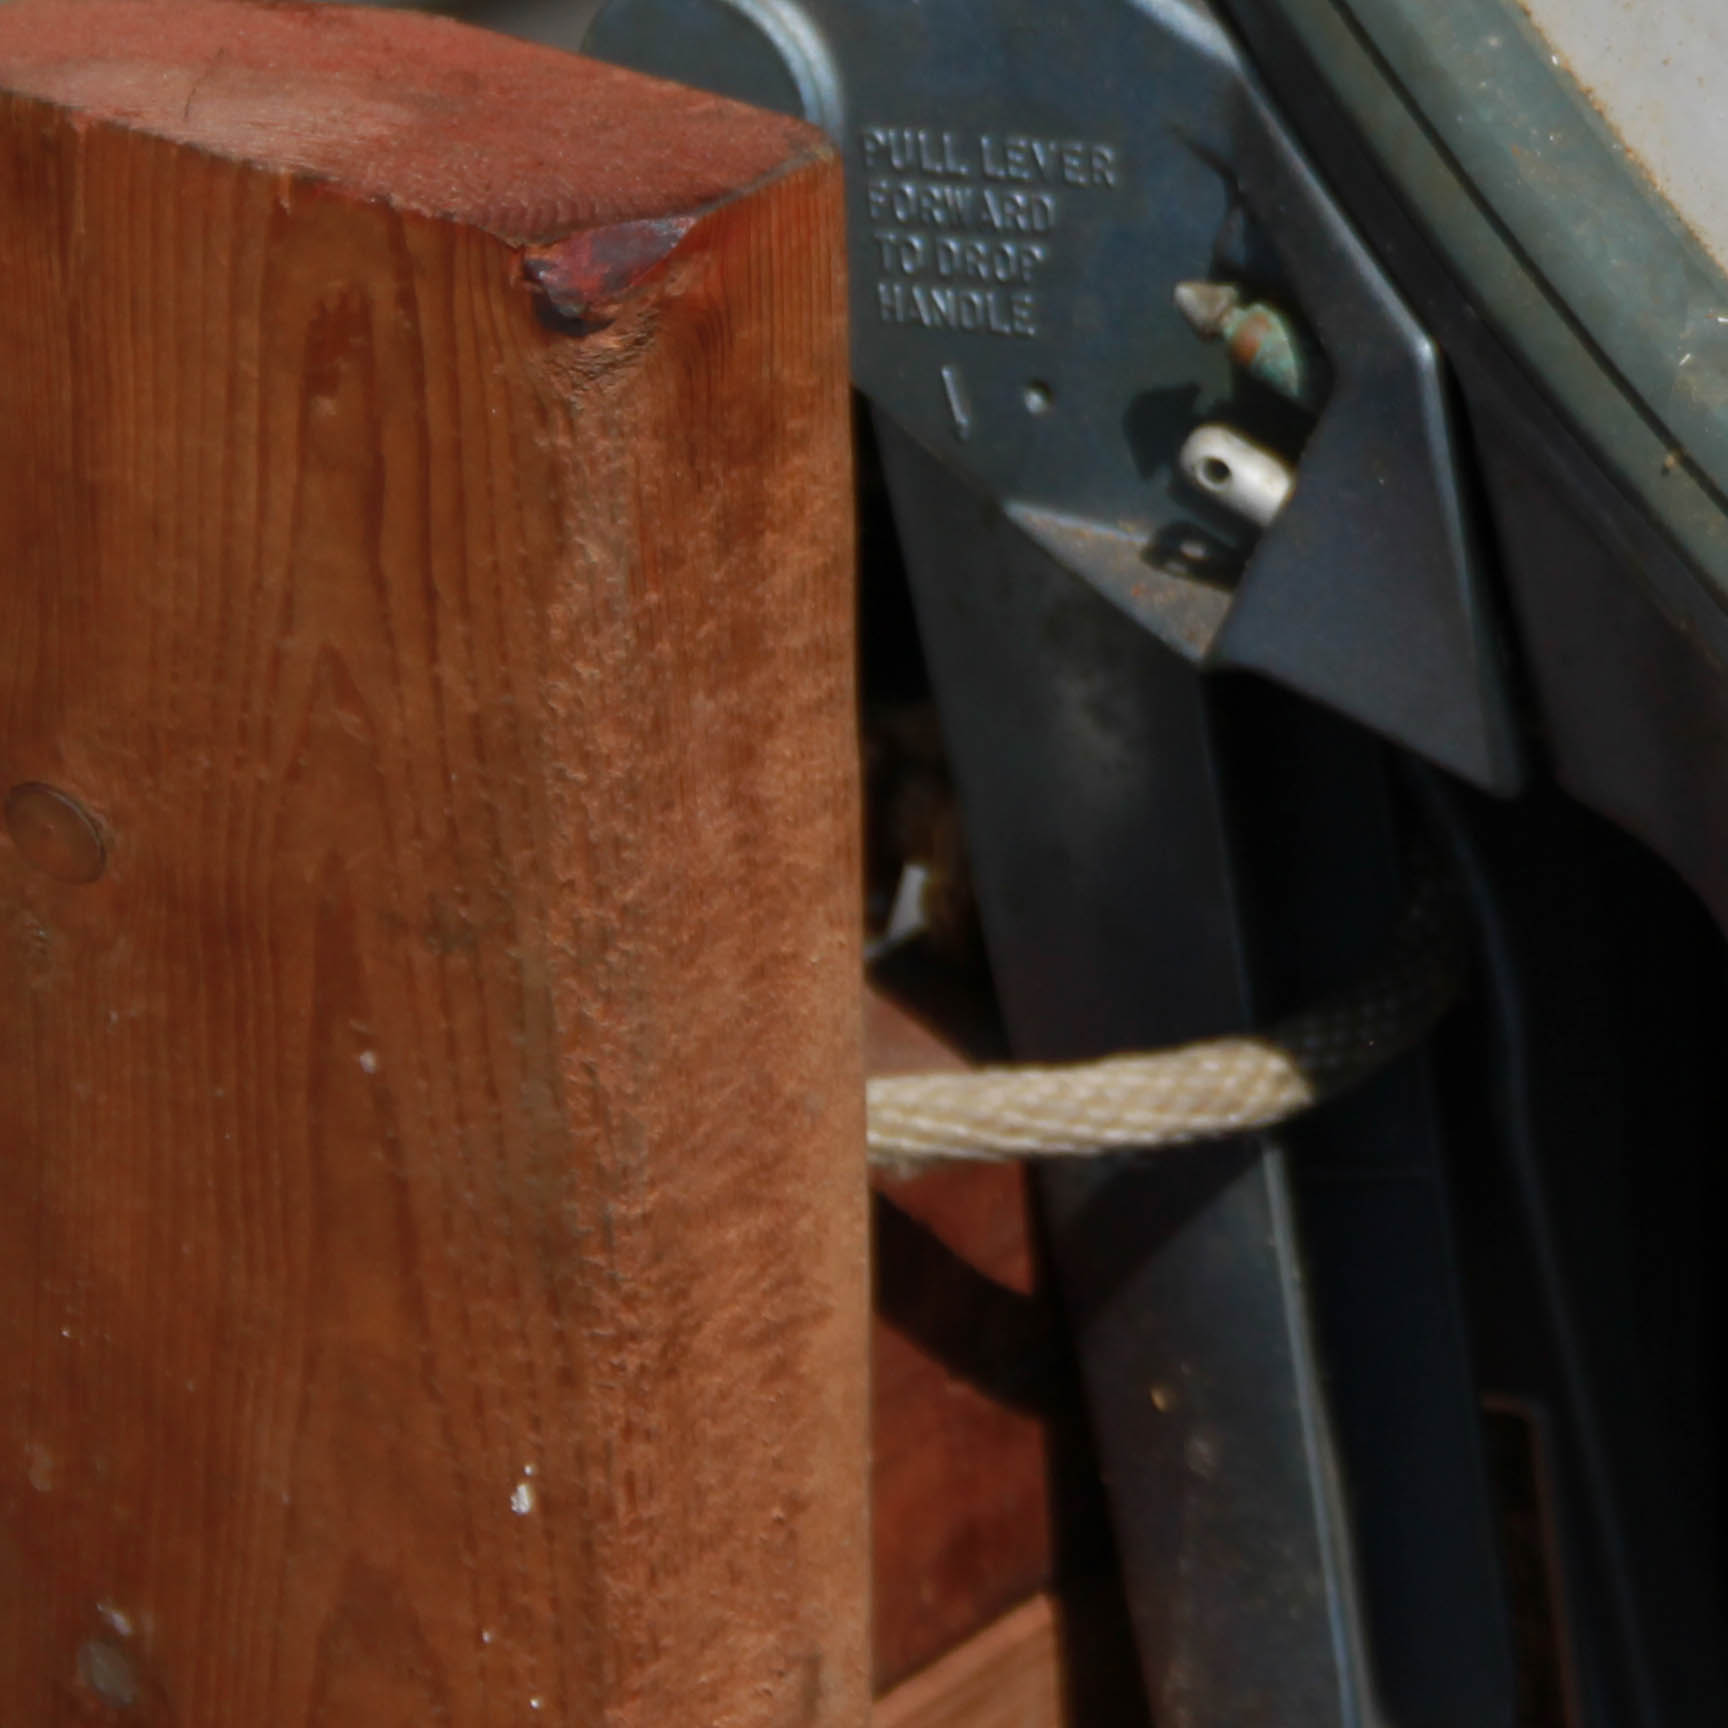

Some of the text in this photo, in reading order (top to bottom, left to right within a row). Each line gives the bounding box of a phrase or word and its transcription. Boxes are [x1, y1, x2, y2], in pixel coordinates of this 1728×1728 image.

[863, 127, 1119, 188] PULL LEVER
[868, 179, 1056, 231] FORWARD
[874, 232, 1047, 283] TO DROP
[877, 282, 1038, 336] HANDLE
